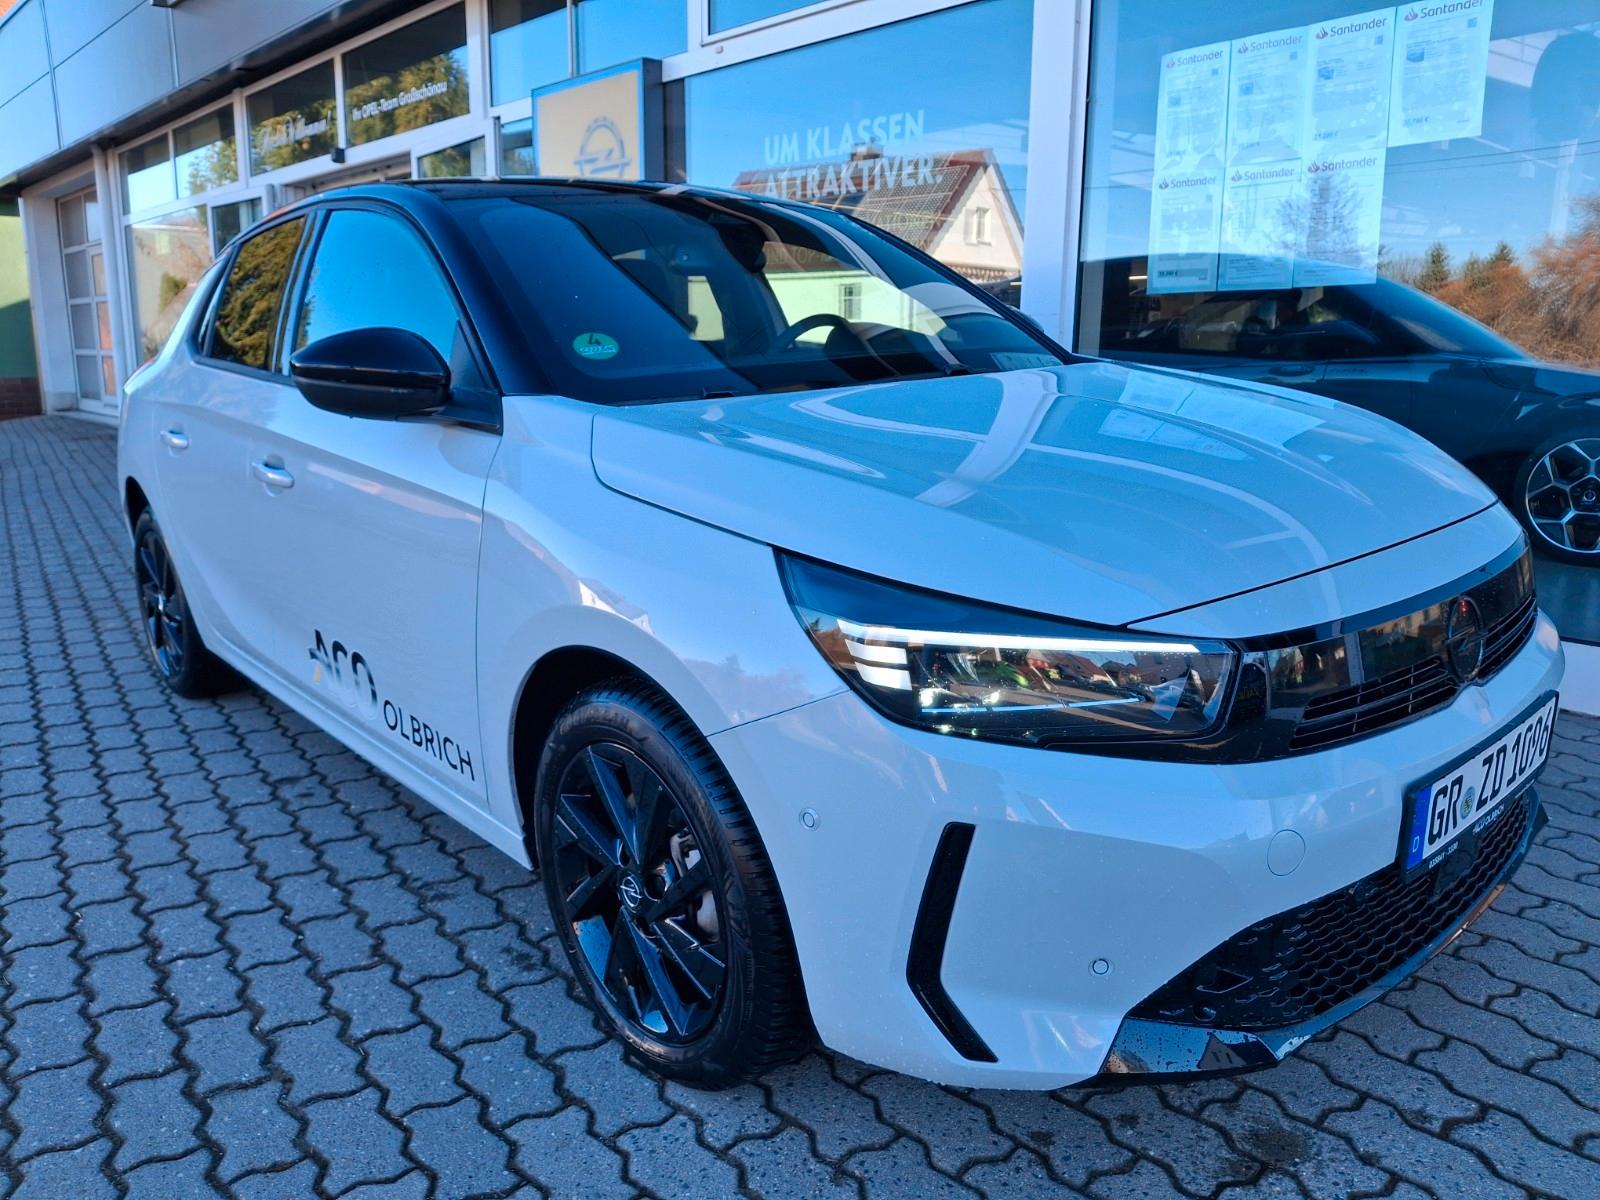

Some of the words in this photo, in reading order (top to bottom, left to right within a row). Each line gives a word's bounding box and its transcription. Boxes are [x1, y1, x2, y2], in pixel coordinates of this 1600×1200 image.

[1420, 0, 1483, 18] Santander
[1330, 17, 1387, 37] Santander
[1250, 34, 1303, 52] Santander
[1177, 50, 1224, 66] Santander
[764, 132, 799, 165] UM
[806, 109, 925, 161] KLASSEN
[1321, 157, 1377, 172] Santander
[764, 155, 944, 200] ATTRAKTIVER.
[1170, 176, 1217, 189] Santander
[1244, 168, 1295, 181] Santander
[383, 699, 476, 782] OLBRICH
[1427, 774, 1464, 845] GR
[1475, 743, 1508, 812] ZD
[1506, 706, 1552, 788] 1096
[1412, 835, 1420, 853] D
